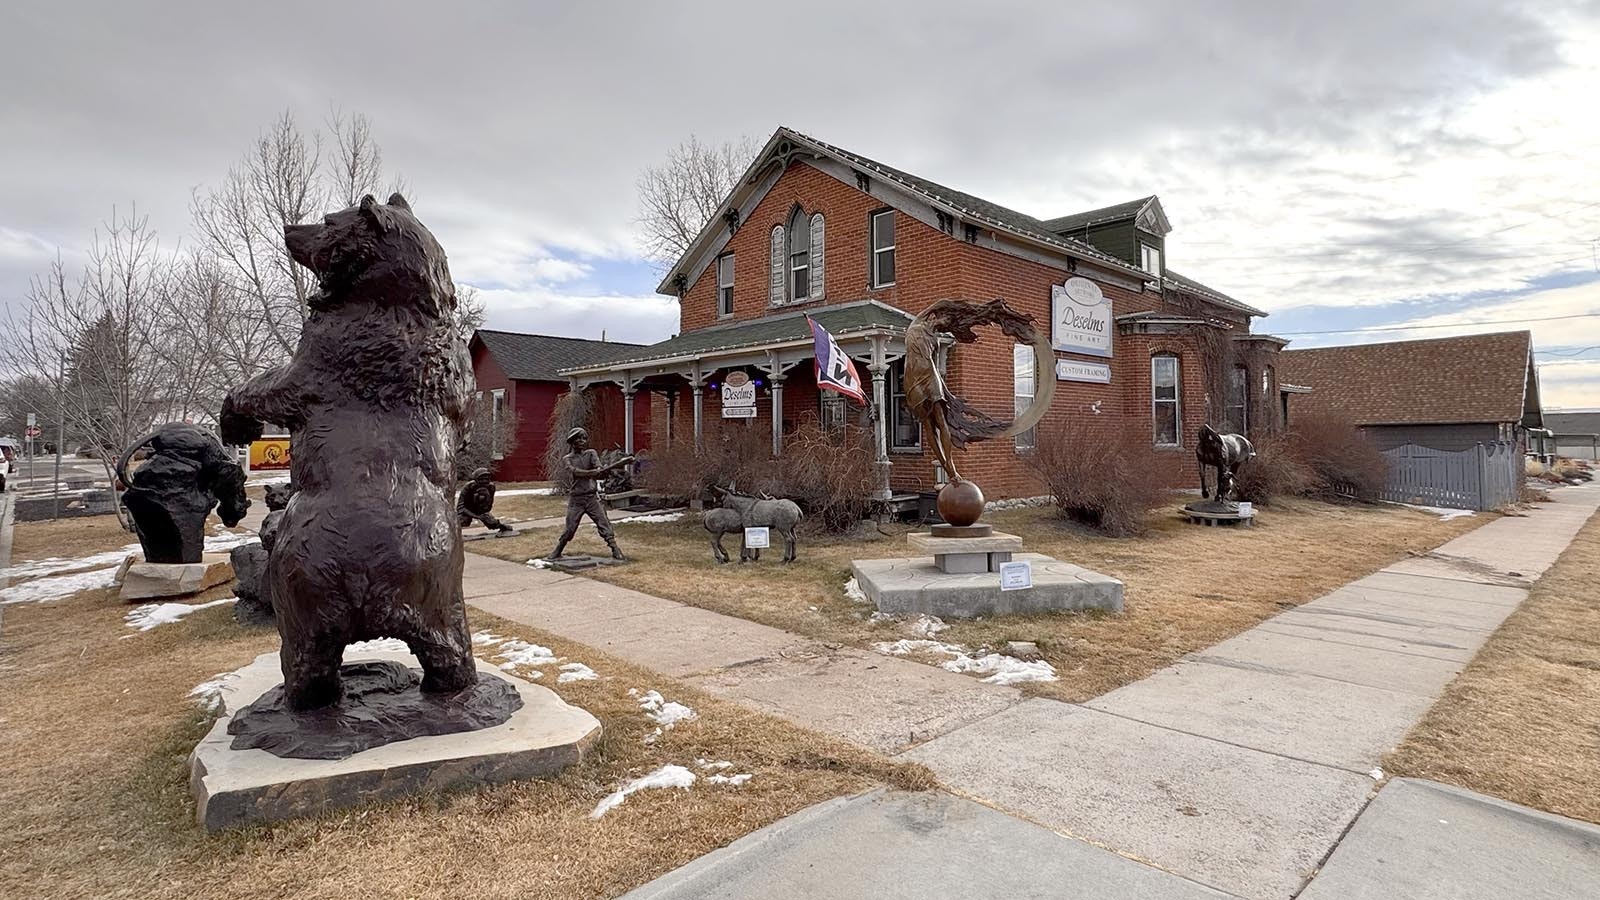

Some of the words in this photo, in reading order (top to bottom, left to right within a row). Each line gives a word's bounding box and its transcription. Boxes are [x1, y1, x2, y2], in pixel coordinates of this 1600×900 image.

[1062, 306, 1105, 332] Deselms
[1065, 333, 1083, 341] FINE
[1061, 366, 1083, 375] CUSTOM
[1084, 368, 1107, 378] FRAMING
[724, 387, 753, 400] Deselms
